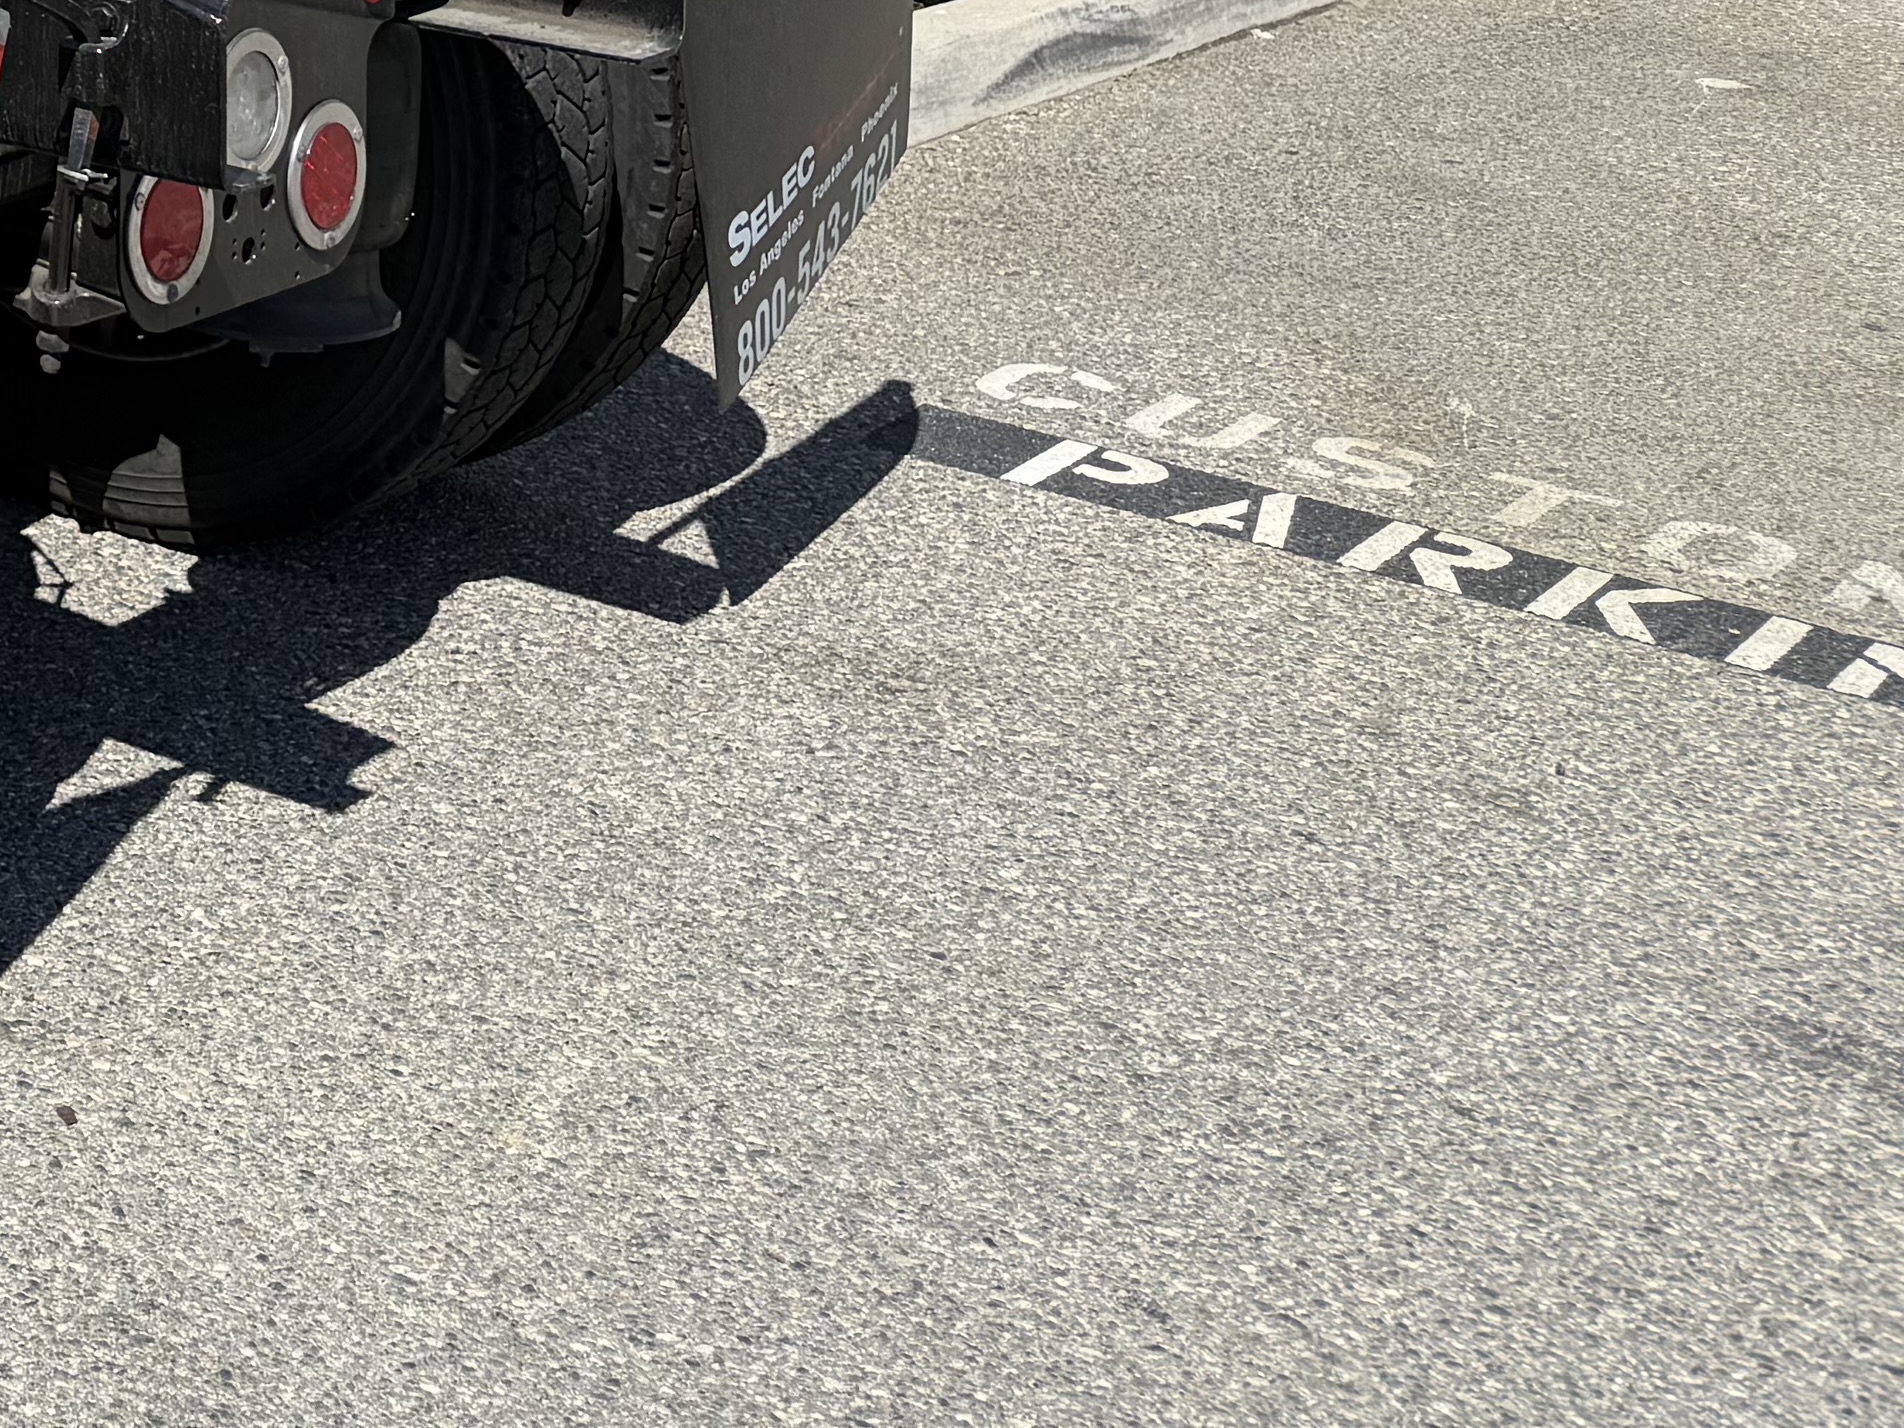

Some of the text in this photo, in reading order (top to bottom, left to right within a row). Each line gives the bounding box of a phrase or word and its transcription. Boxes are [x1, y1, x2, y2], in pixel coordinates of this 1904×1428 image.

[733, 82, 899, 306] Los Angeles Fontana Phoenix
[737, 119, 898, 387] 800-543-7621
